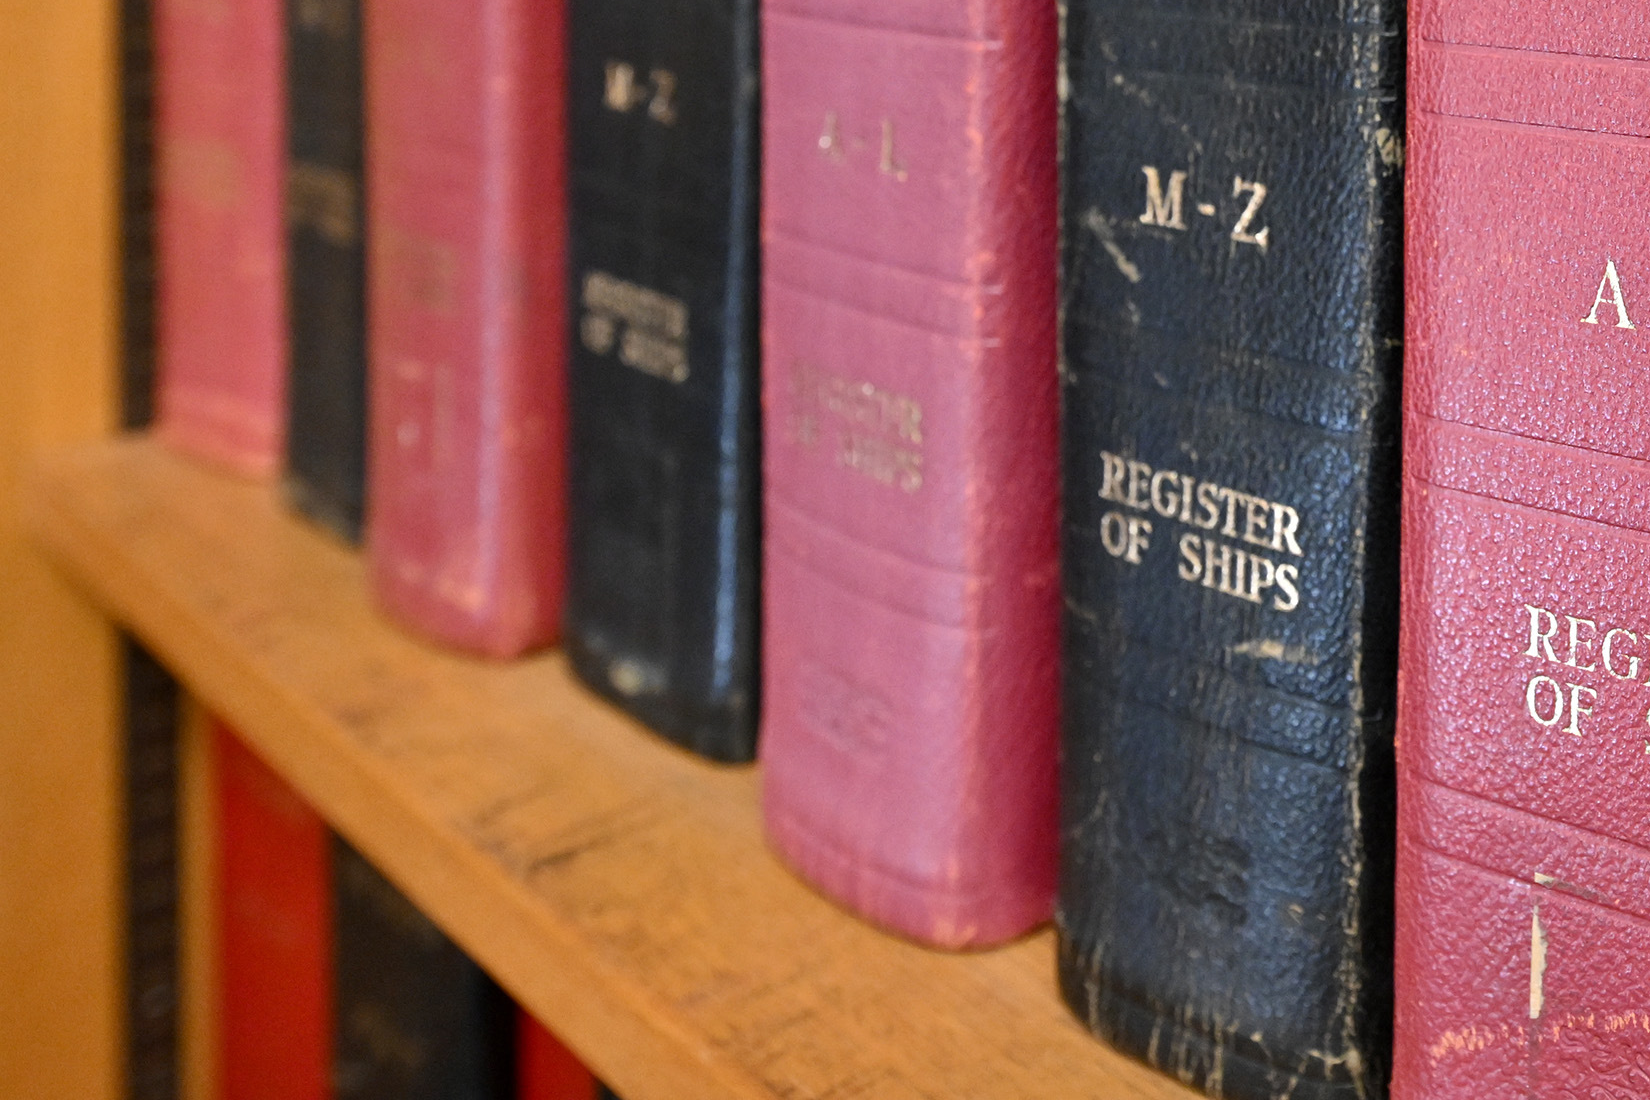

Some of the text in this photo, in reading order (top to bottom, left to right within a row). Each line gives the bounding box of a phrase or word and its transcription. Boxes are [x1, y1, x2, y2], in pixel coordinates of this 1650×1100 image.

[1139, 166, 1187, 232] M
[1231, 175, 1269, 247] Z
[1579, 260, 1636, 330] A
[1098, 450, 1303, 557] REGISTER
[1100, 510, 1300, 613] OF SHIPS
[1526, 674, 1598, 738] OF
